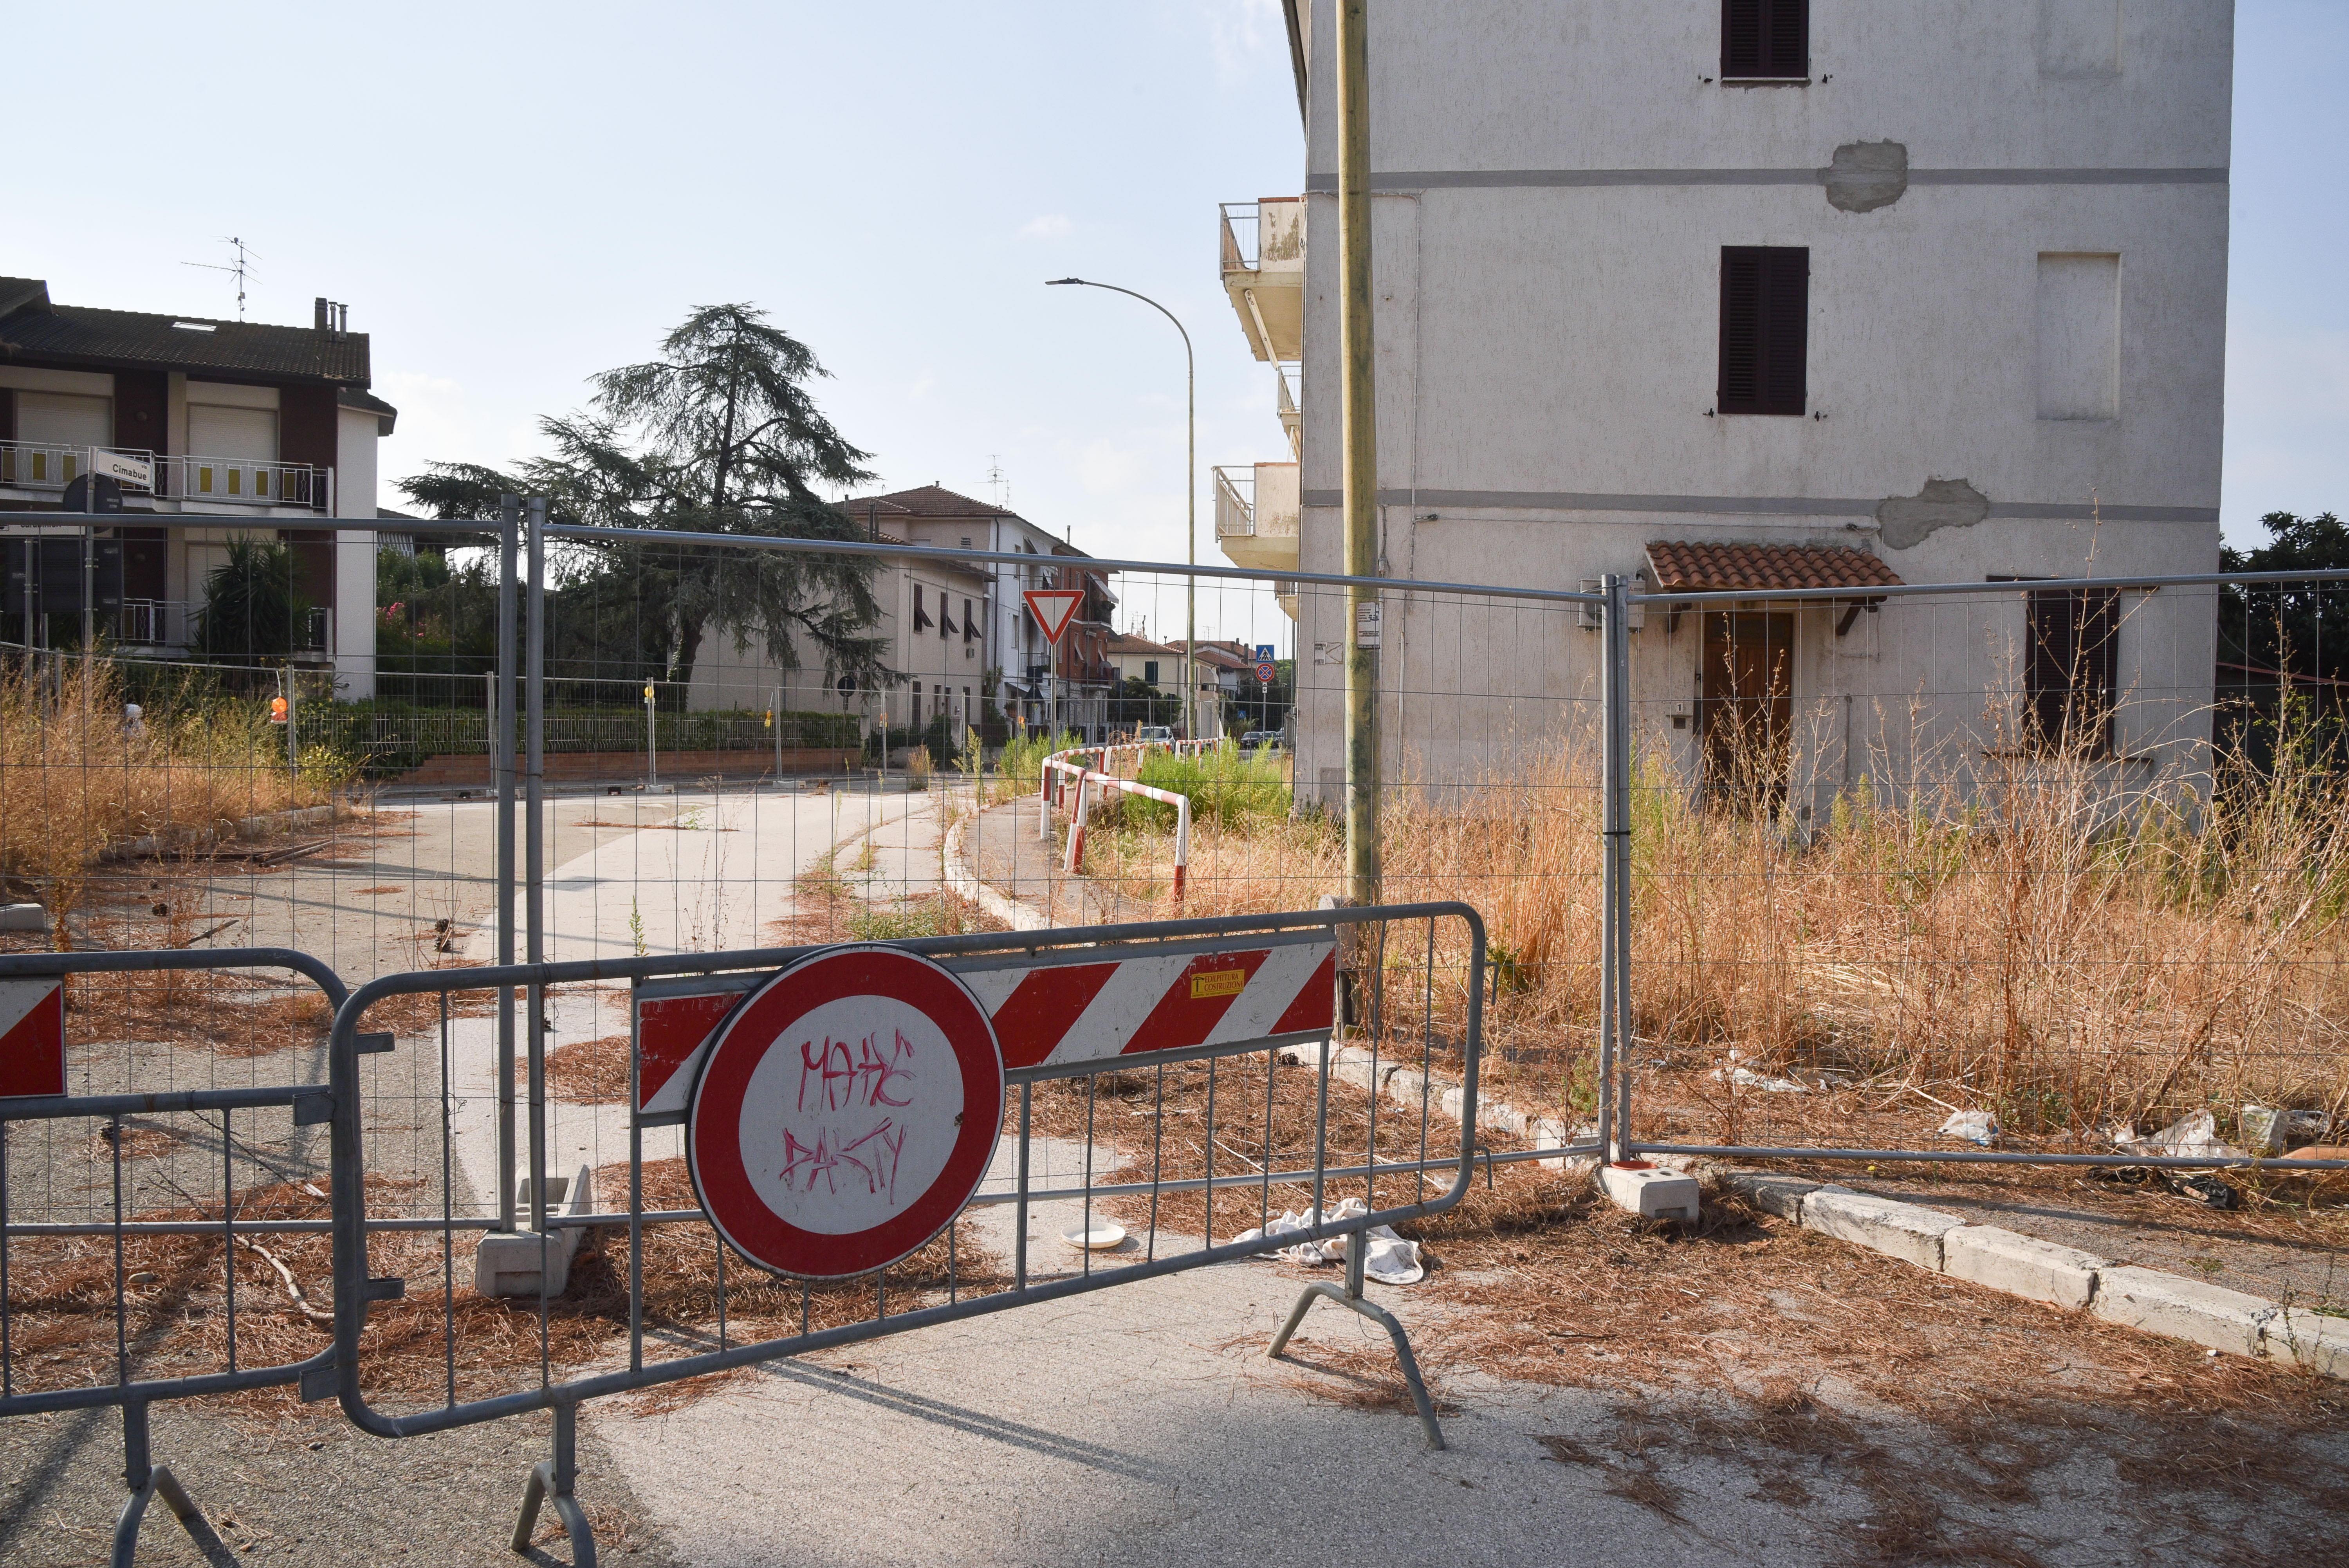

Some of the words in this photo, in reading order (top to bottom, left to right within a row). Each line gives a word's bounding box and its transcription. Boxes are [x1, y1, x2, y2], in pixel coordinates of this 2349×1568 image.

[113, 464, 147, 480] Cimabue
[1205, 973, 1239, 983] EDILPITTURA
[1204, 981, 1243, 991] COSTRUZIONI
